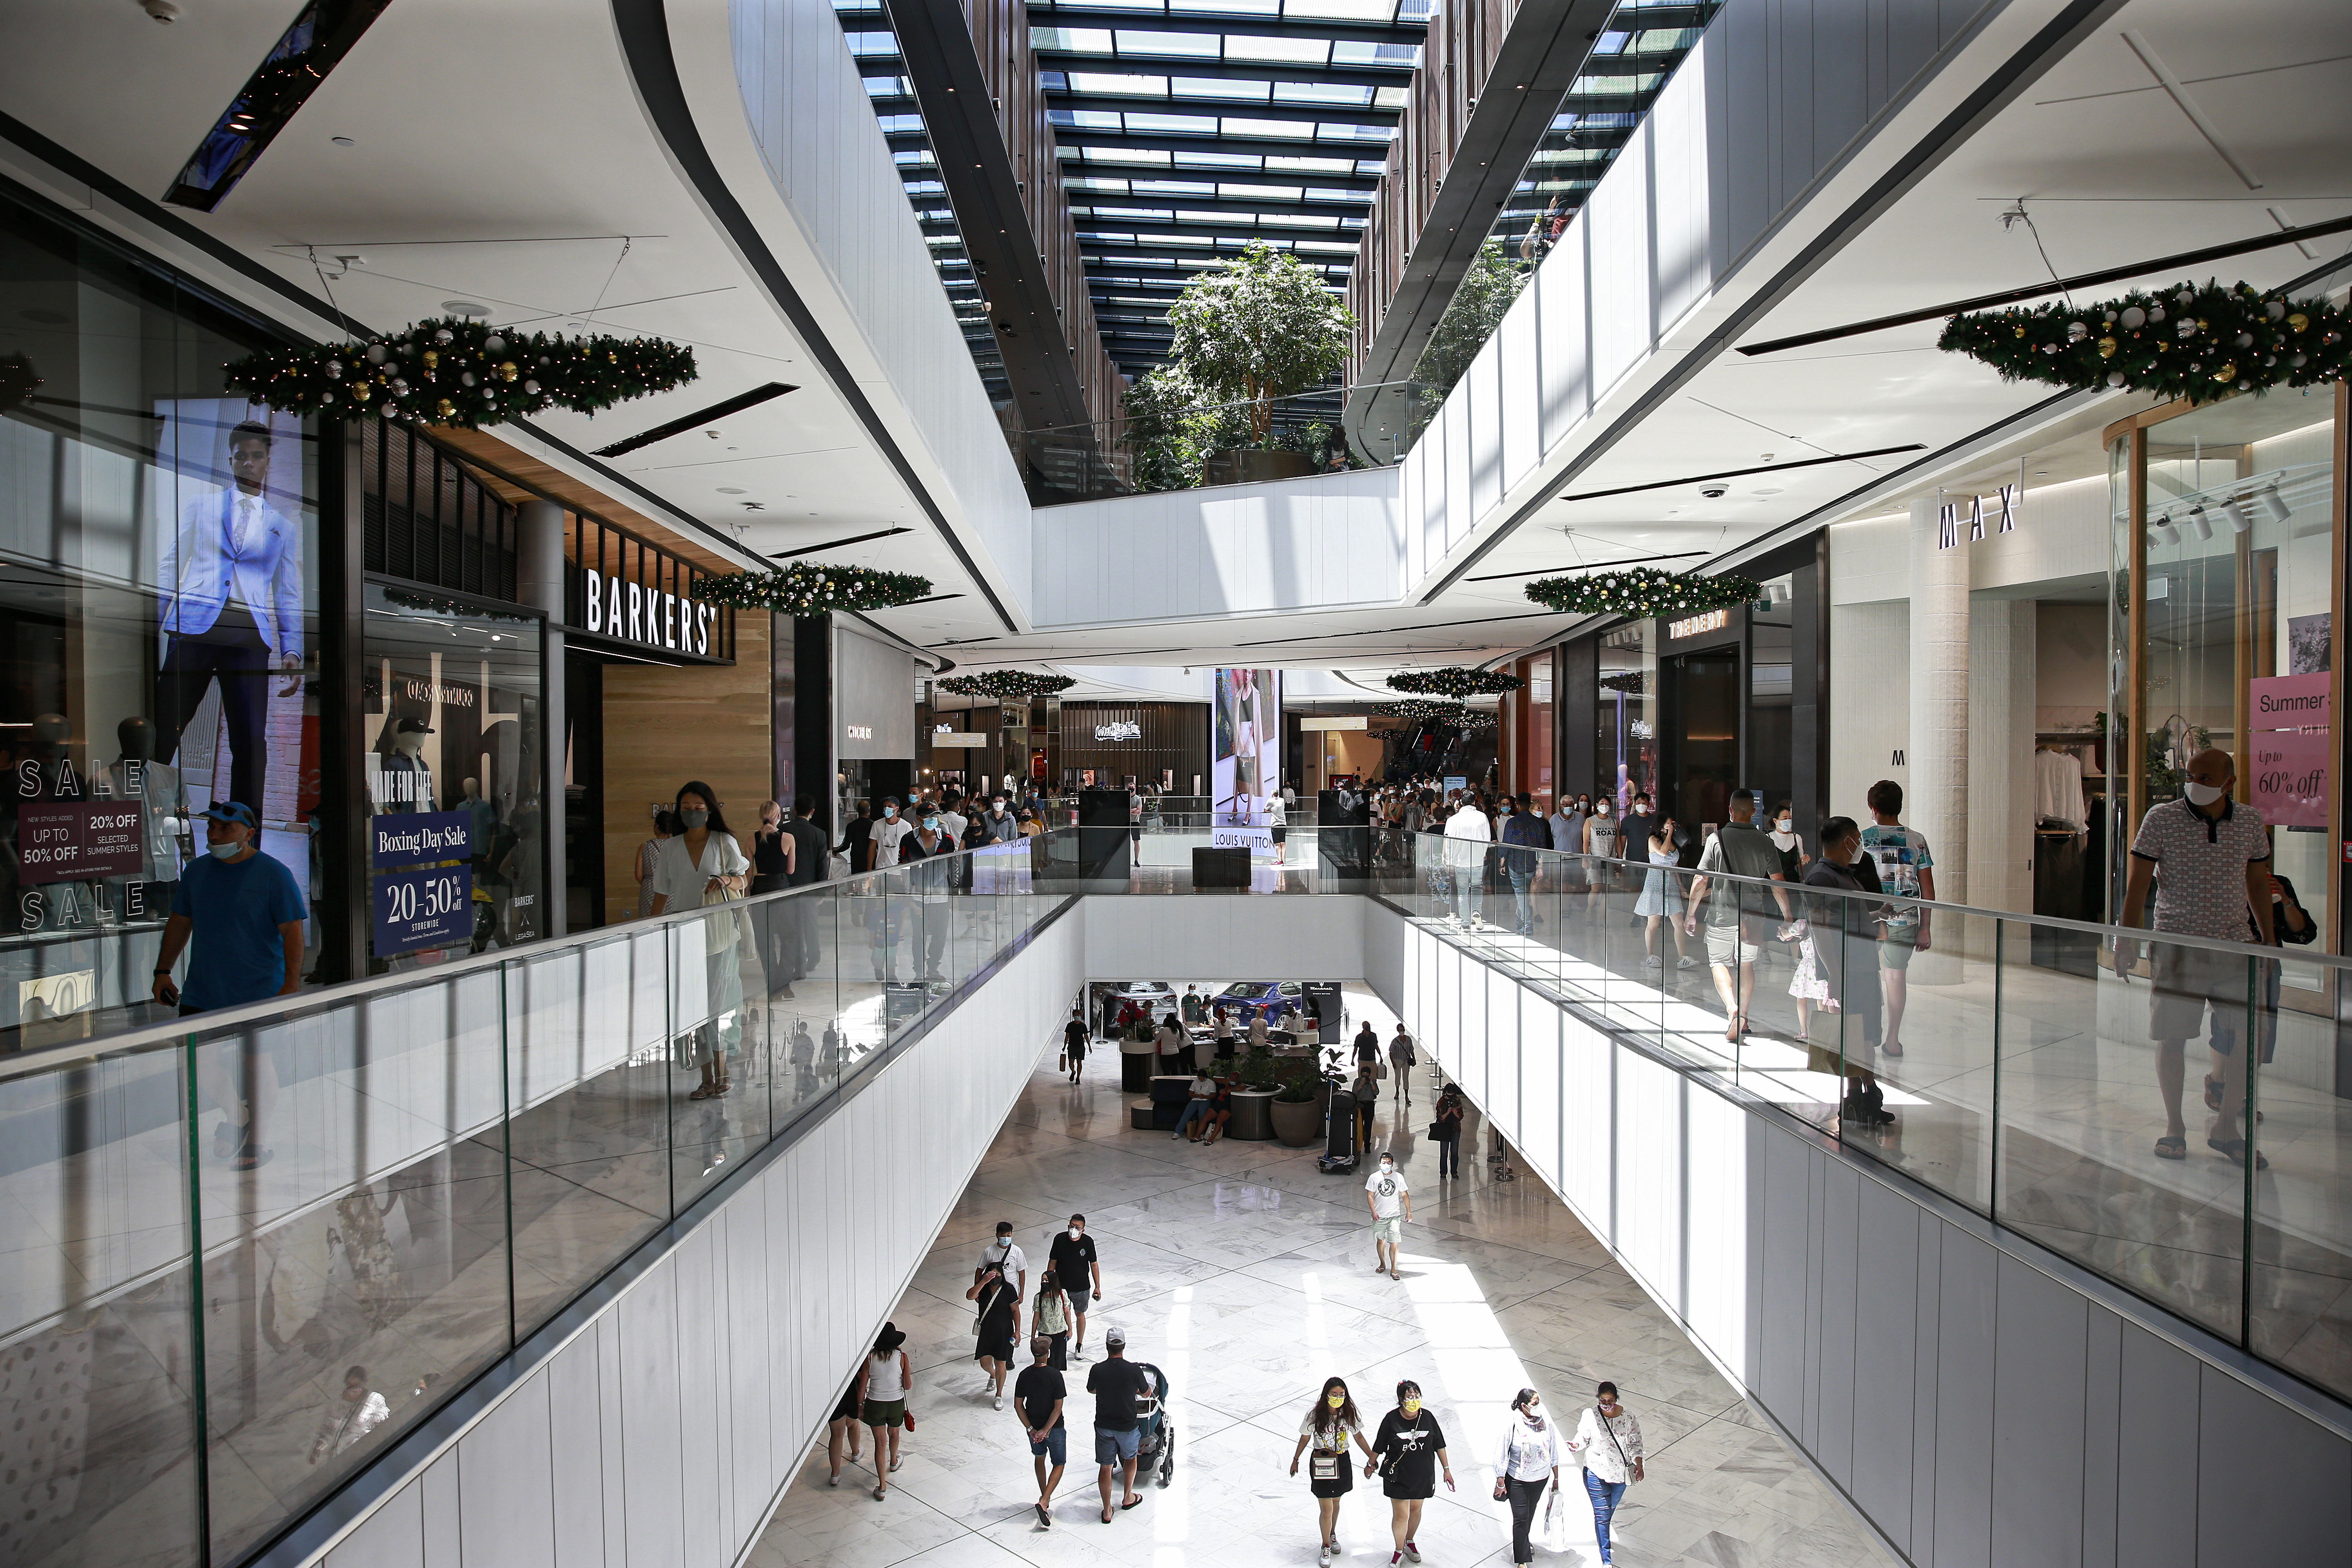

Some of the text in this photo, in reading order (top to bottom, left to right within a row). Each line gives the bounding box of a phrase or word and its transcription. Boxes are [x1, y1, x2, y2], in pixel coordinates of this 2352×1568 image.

[1939, 484, 2015, 550] MAX
[1669, 609, 1723, 639] TRENERY
[2260, 695, 2325, 712] Summer
[2259, 750, 2282, 765] Up to
[19, 759, 142, 797] SALE
[2259, 772, 2294, 794] 60%
[372, 771, 395, 803] MADE
[397, 771, 413, 802] FOR
[90, 814, 137, 829] 20% OFF
[34, 828, 69, 843] UP TO
[98, 835, 128, 844] SELECTED
[379, 826, 466, 855] Boxing Day Sale
[1215, 833, 1275, 849] LOUIS VUITTON
[24, 846, 78, 863] 50% OFF
[87, 844, 138, 855] SUMMER STYLES
[21, 880, 144, 930] SALE
[453, 898, 462, 911] off
[1402, 1442, 1424, 1451] BOY
